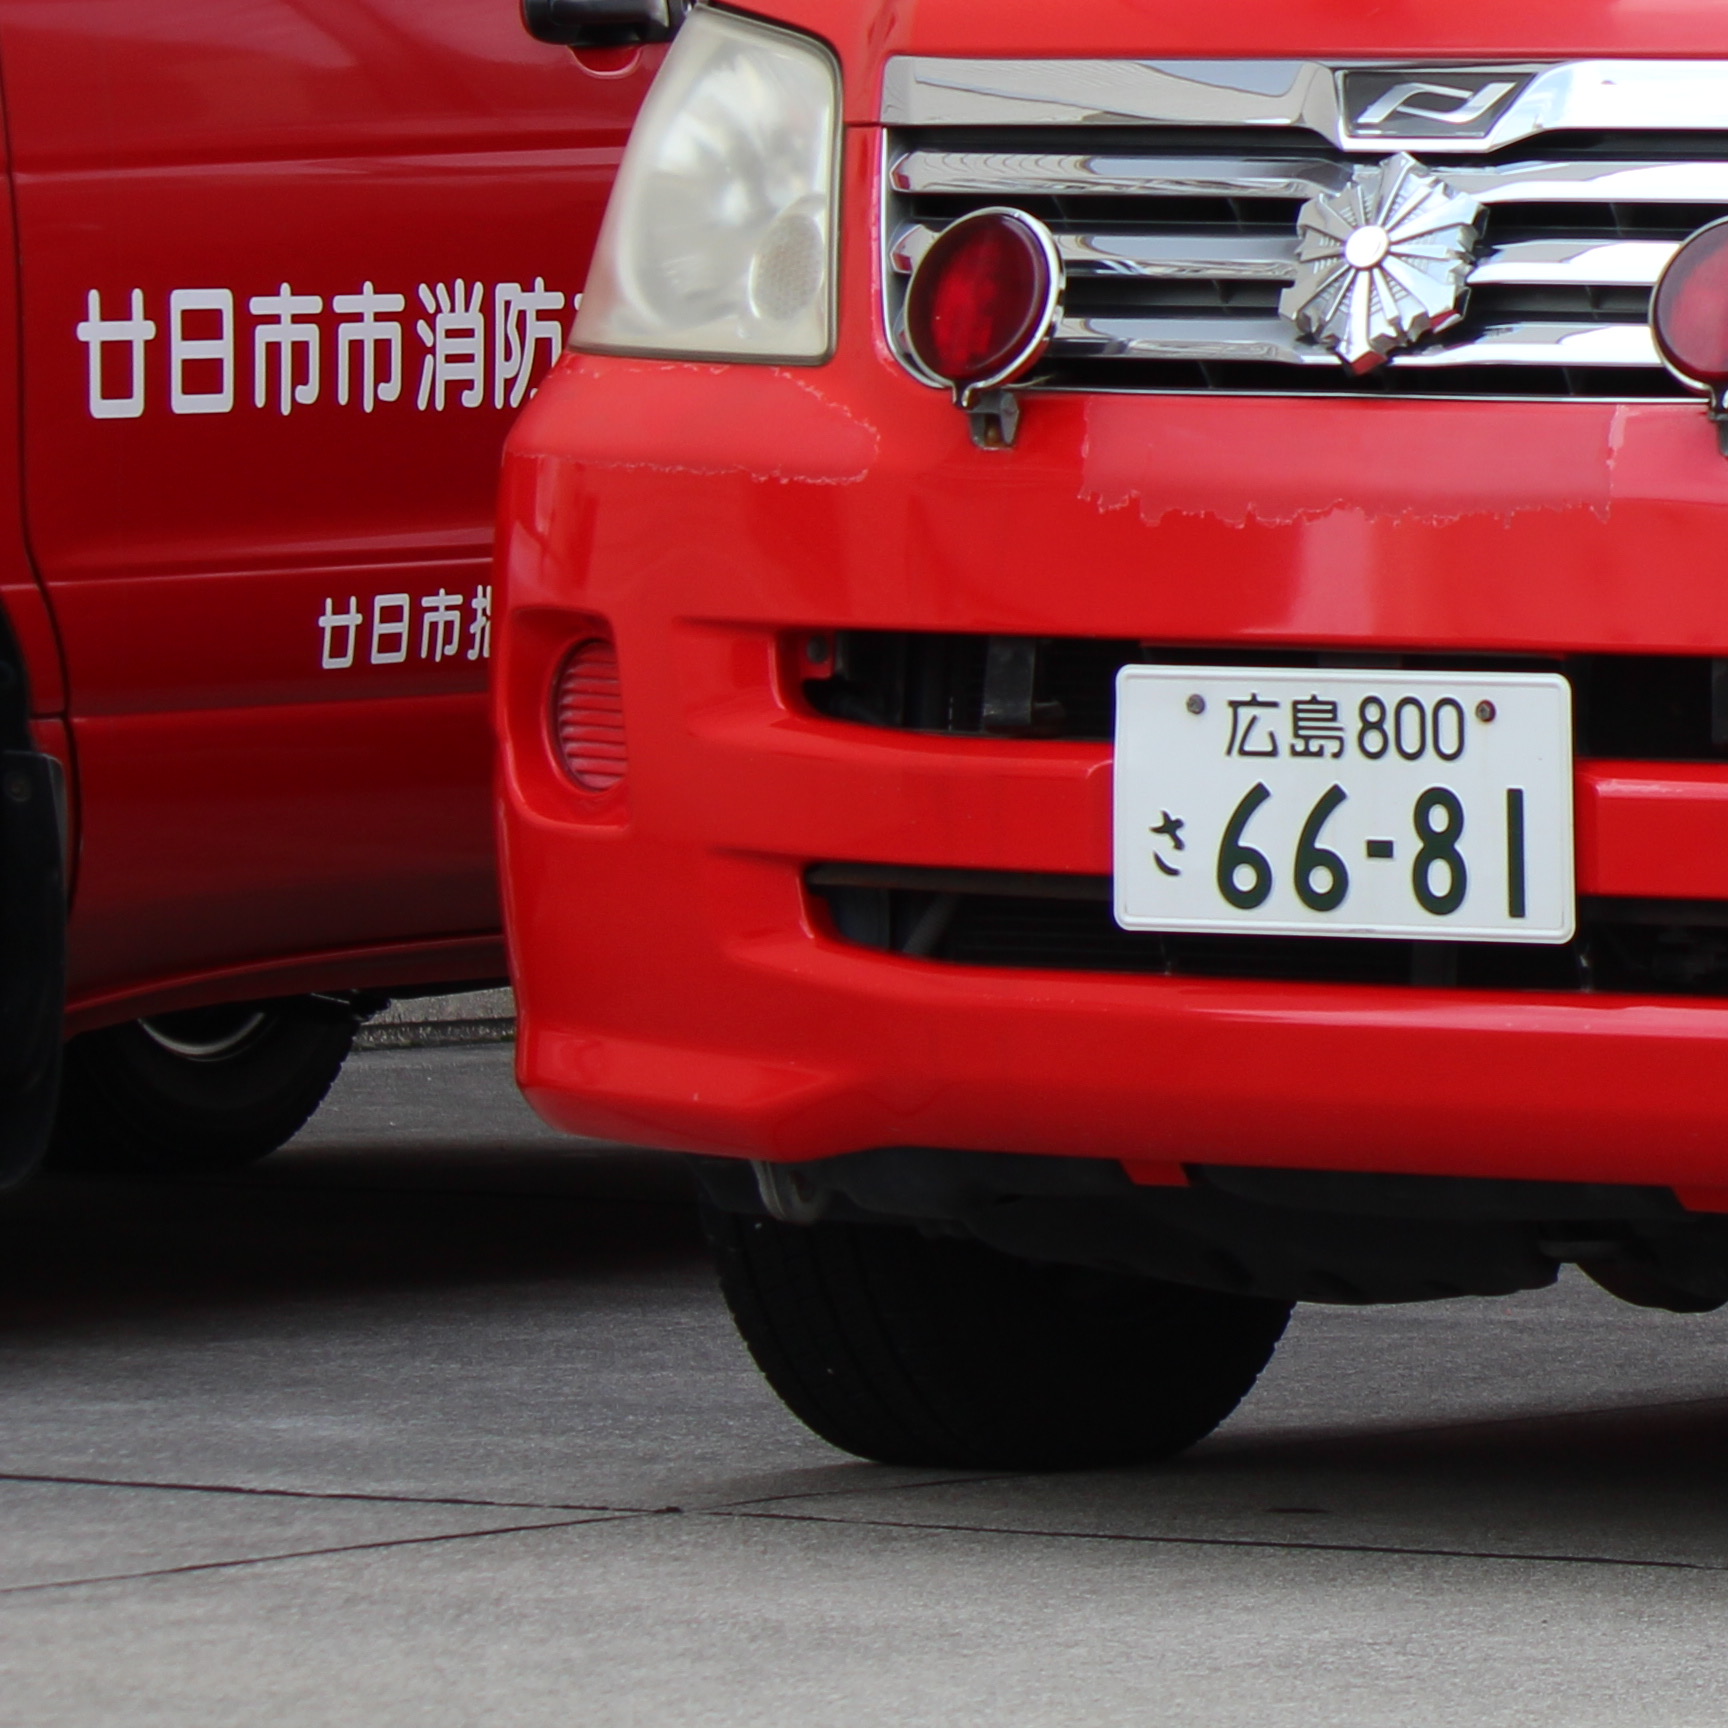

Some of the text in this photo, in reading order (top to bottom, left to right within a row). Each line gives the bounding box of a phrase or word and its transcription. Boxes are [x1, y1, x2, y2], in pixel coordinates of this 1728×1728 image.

[76, 276, 583, 419] 廿日市市消防
[1225, 693, 1465, 761] 広島 800
[1149, 781, 1526, 919] さ 66-81
